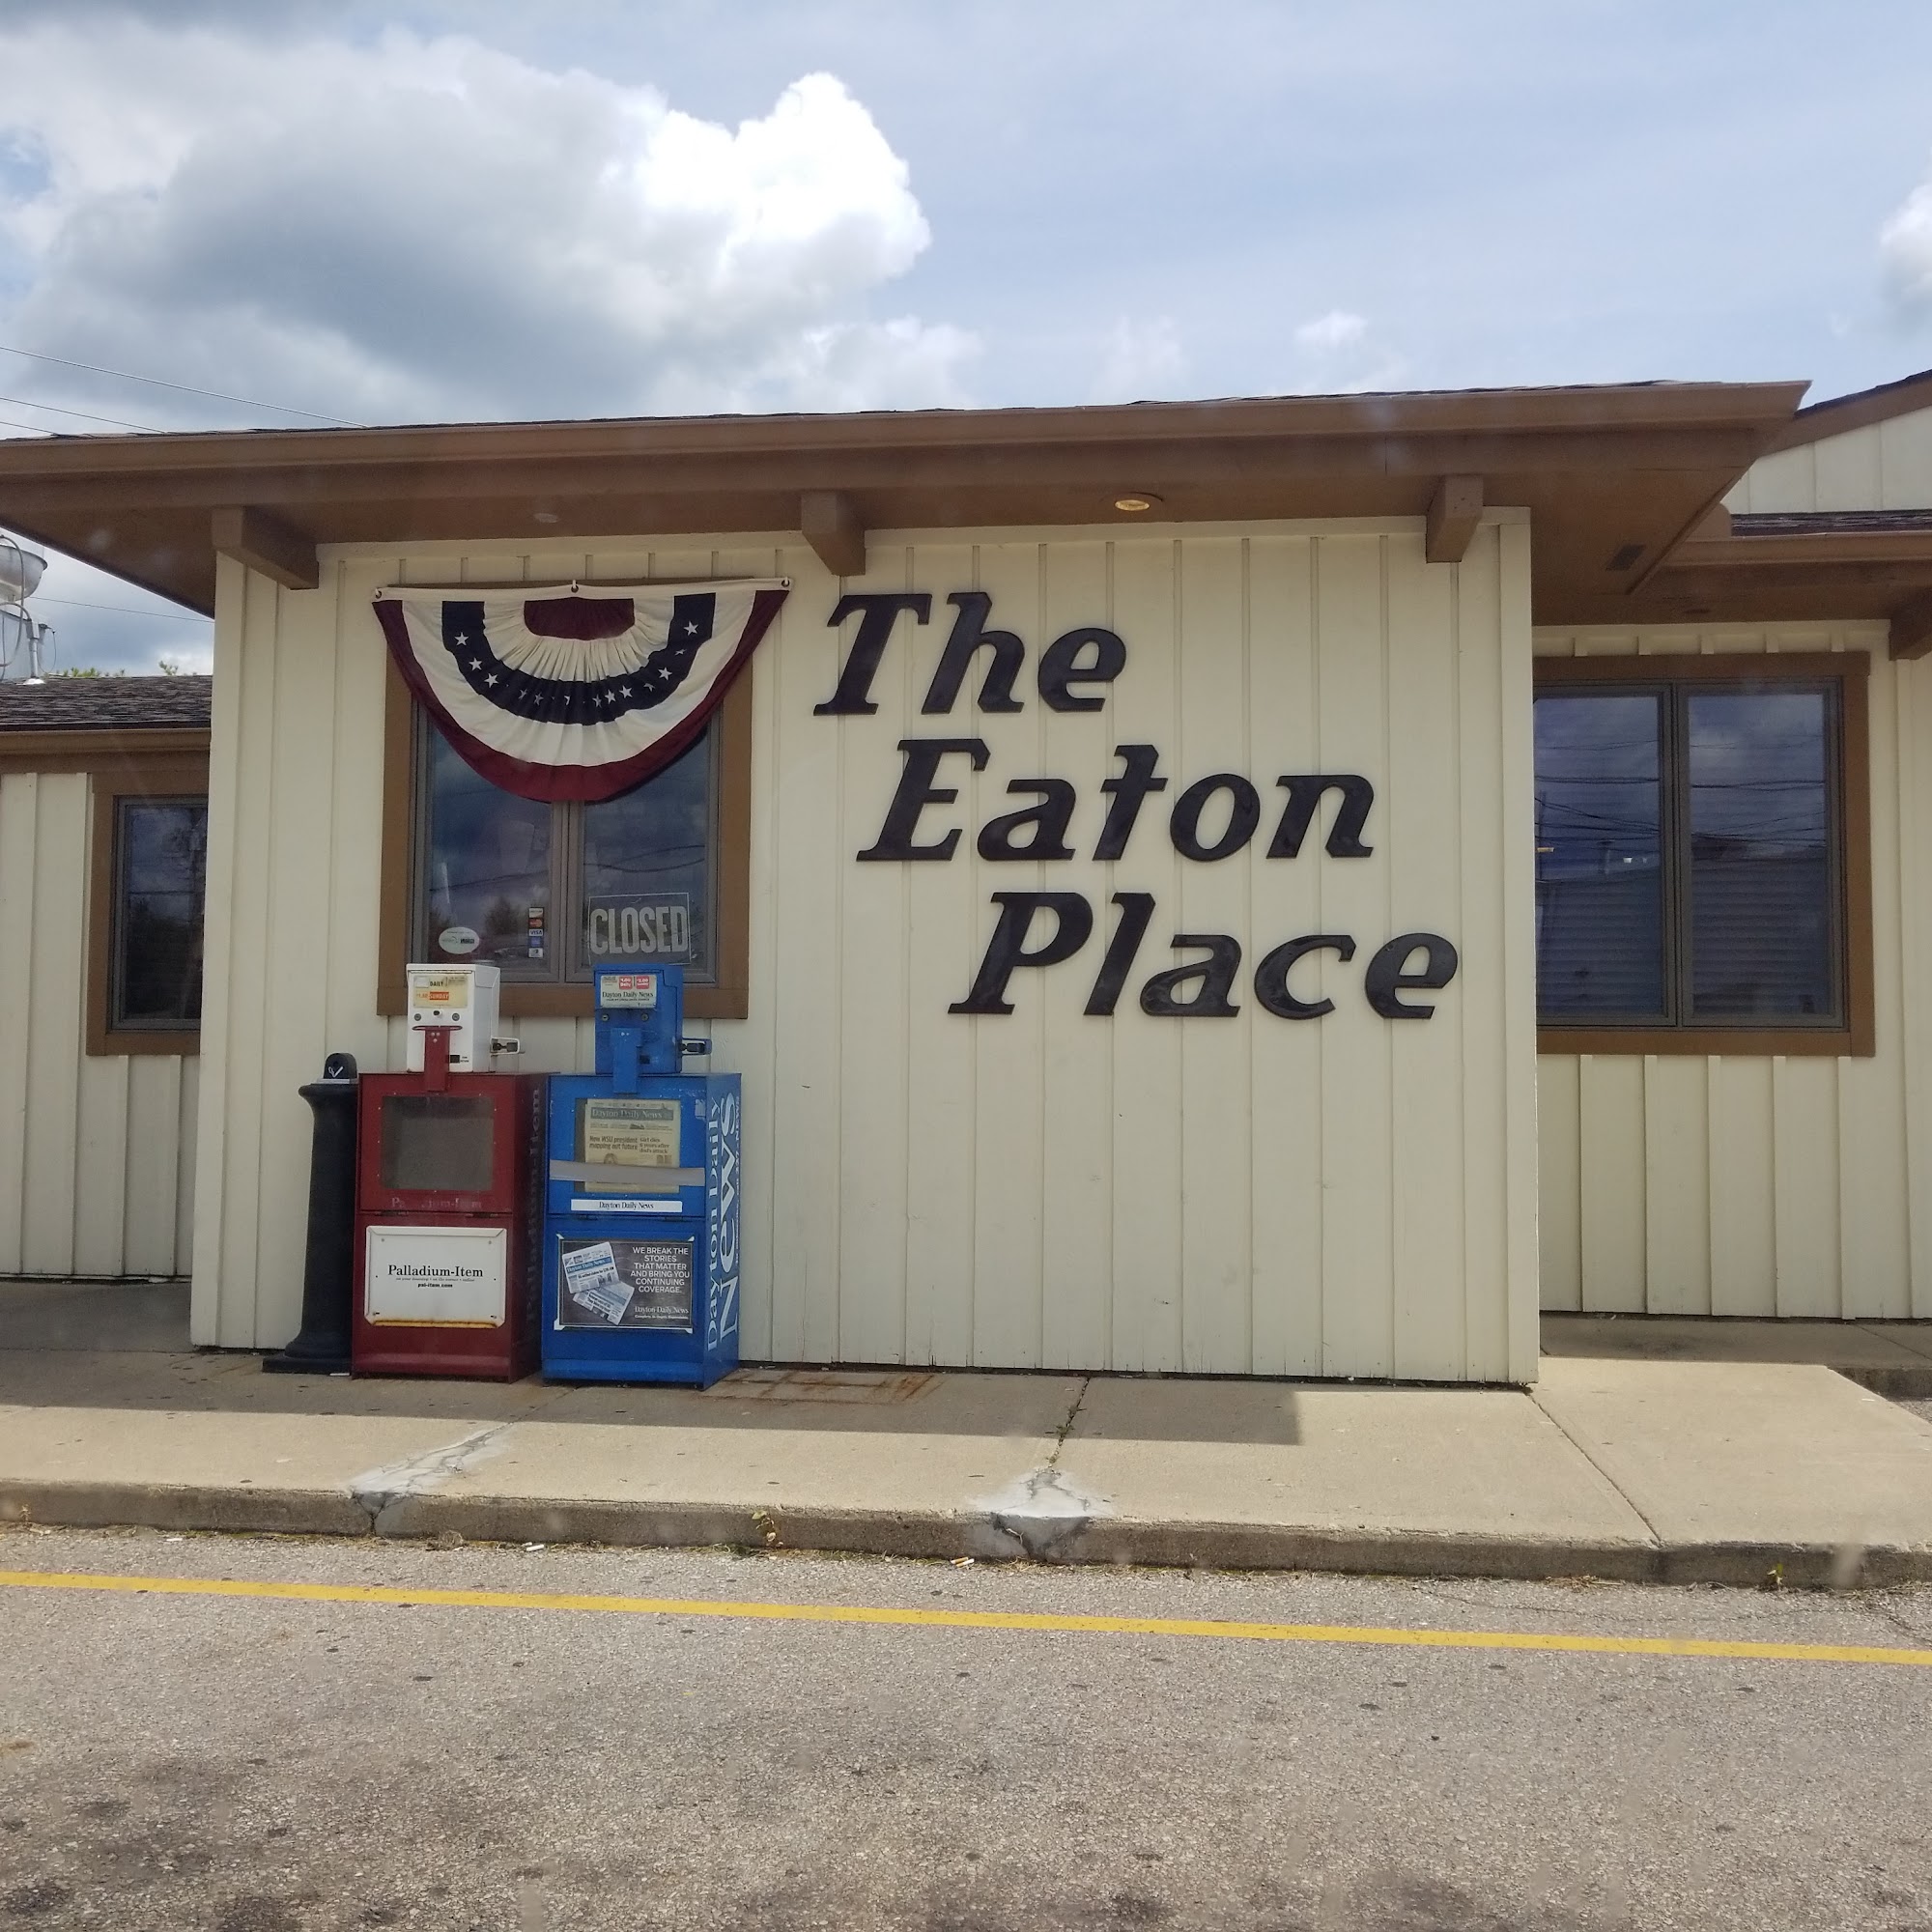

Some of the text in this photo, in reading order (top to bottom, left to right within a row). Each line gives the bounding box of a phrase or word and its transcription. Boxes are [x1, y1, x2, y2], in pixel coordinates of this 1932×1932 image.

[812, 591, 1127, 716] The
[856, 738, 1375, 862] Eaton
[589, 906, 688, 954] CLOSED
[948, 892, 1459, 1021] Place
[592, 1109, 618, 1118] Dayton
[620, 1110, 639, 1119] Daily
[599, 1201, 620, 1209] Dayton
[707, 1096, 720, 1351] Dayton Daily
[720, 1092, 738, 1343] News
[387, 1264, 483, 1277] Palladium-Item
